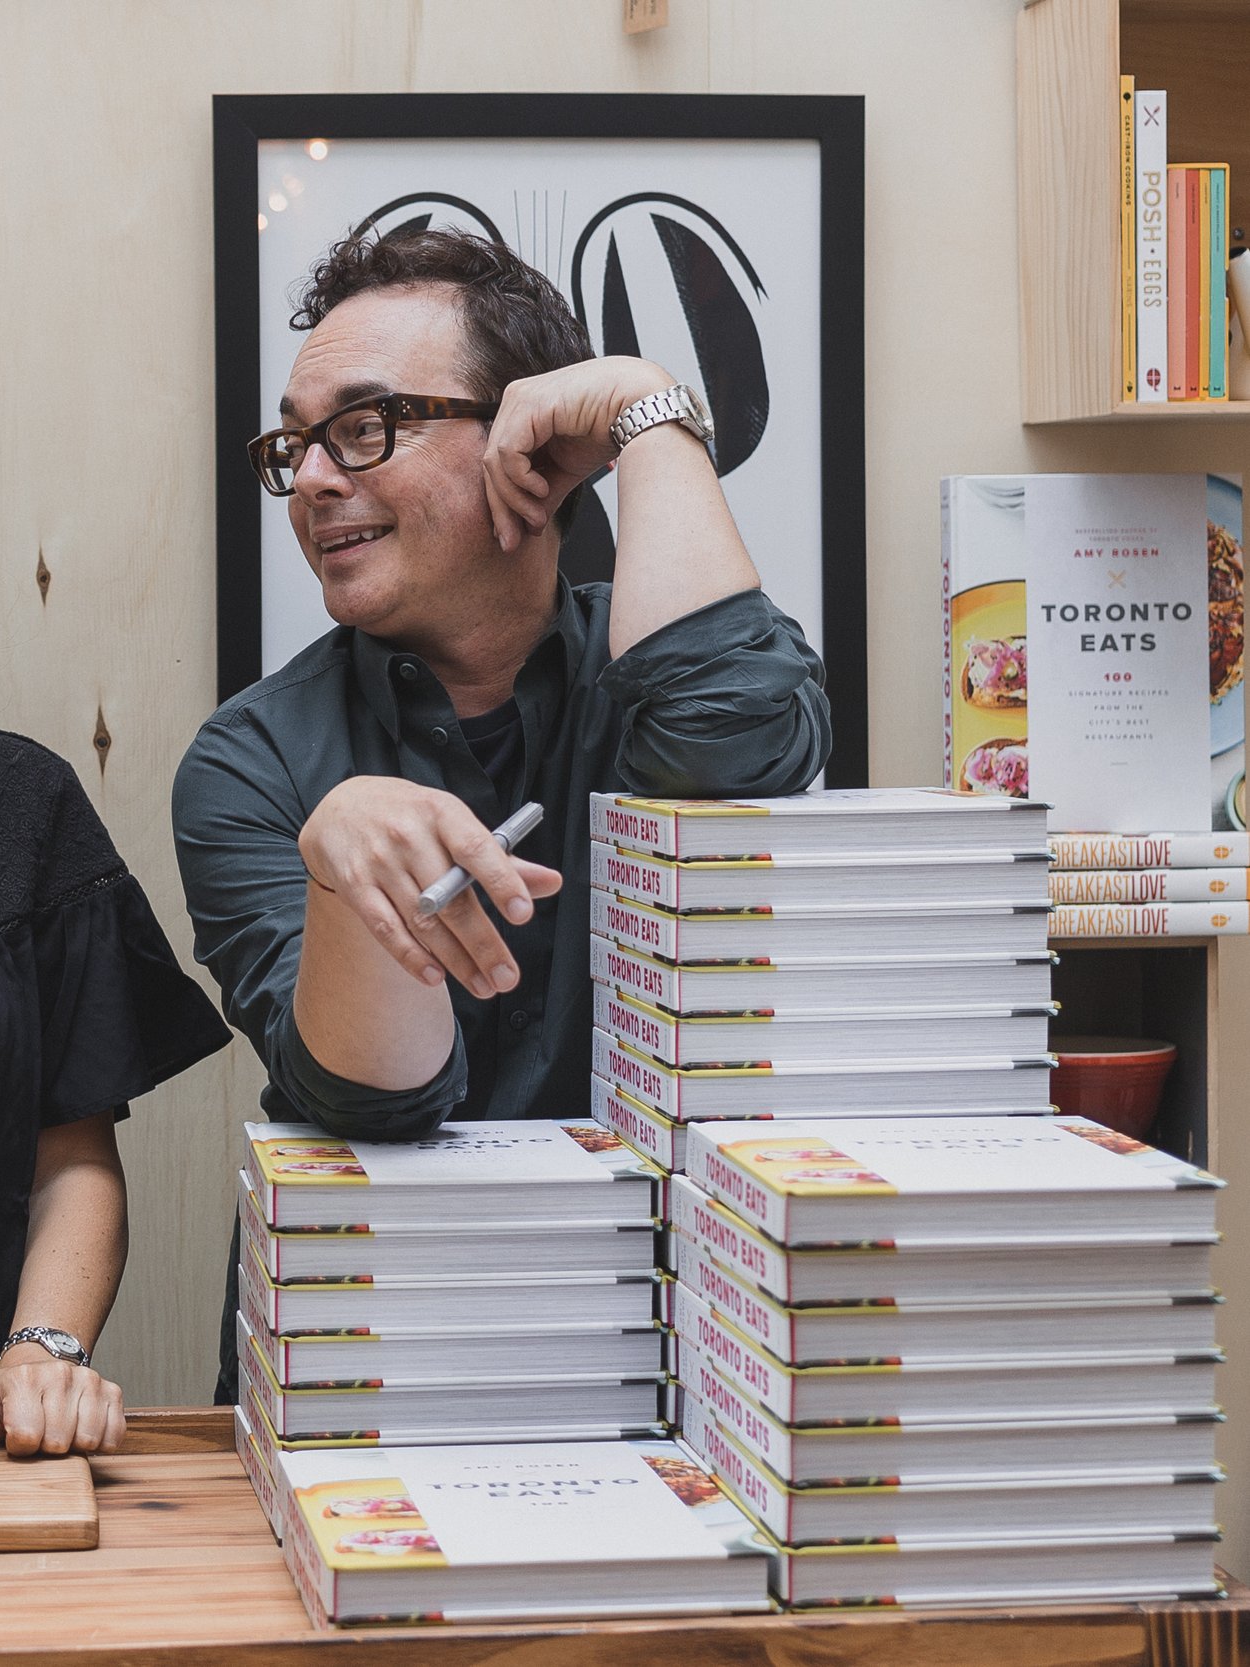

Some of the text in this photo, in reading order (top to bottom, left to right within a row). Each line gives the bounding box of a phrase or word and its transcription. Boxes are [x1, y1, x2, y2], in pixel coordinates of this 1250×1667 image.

[1143, 171, 1162, 308] POSH EGGS
[1041, 602, 1192, 622] TORONTO
[1080, 633, 1156, 652] EATS
[1104, 672, 1132, 682] 100
[606, 810, 638, 838] TORONTO
[640, 818, 658, 844] EATS
[607, 858, 640, 889] TORONTO
[642, 868, 660, 896] EATS
[607, 906, 639, 938] TORONTO
[642, 918, 660, 946] EATS
[608, 953, 641, 987] TORONTO
[644, 968, 662, 997] EATS
[608, 1002, 639, 1038] TORONTO
[642, 1020, 659, 1050] EATS
[609, 1050, 640, 1088] TORONTO
[644, 1069, 661, 1101] EATS
[607, 1096, 637, 1138] TORONTO
[640, 1119, 656, 1152] EATS
[706, 1152, 742, 1202] TORONTO
[746, 1182, 766, 1220] EATS
[694, 1206, 737, 1258] TORONTO
[741, 1240, 766, 1278] EATS
[699, 1262, 742, 1316] TORONTO
[745, 1298, 769, 1338] EATS
[698, 1316, 742, 1372] TORONTO
[745, 1354, 769, 1396] EATS
[700, 1367, 742, 1428] TORONTO
[746, 1410, 770, 1453] EATS
[426, 1478, 638, 1490] TORONTO
[704, 1423, 768, 1512] TORONTO EATS
[489, 1488, 596, 1497] EATS
